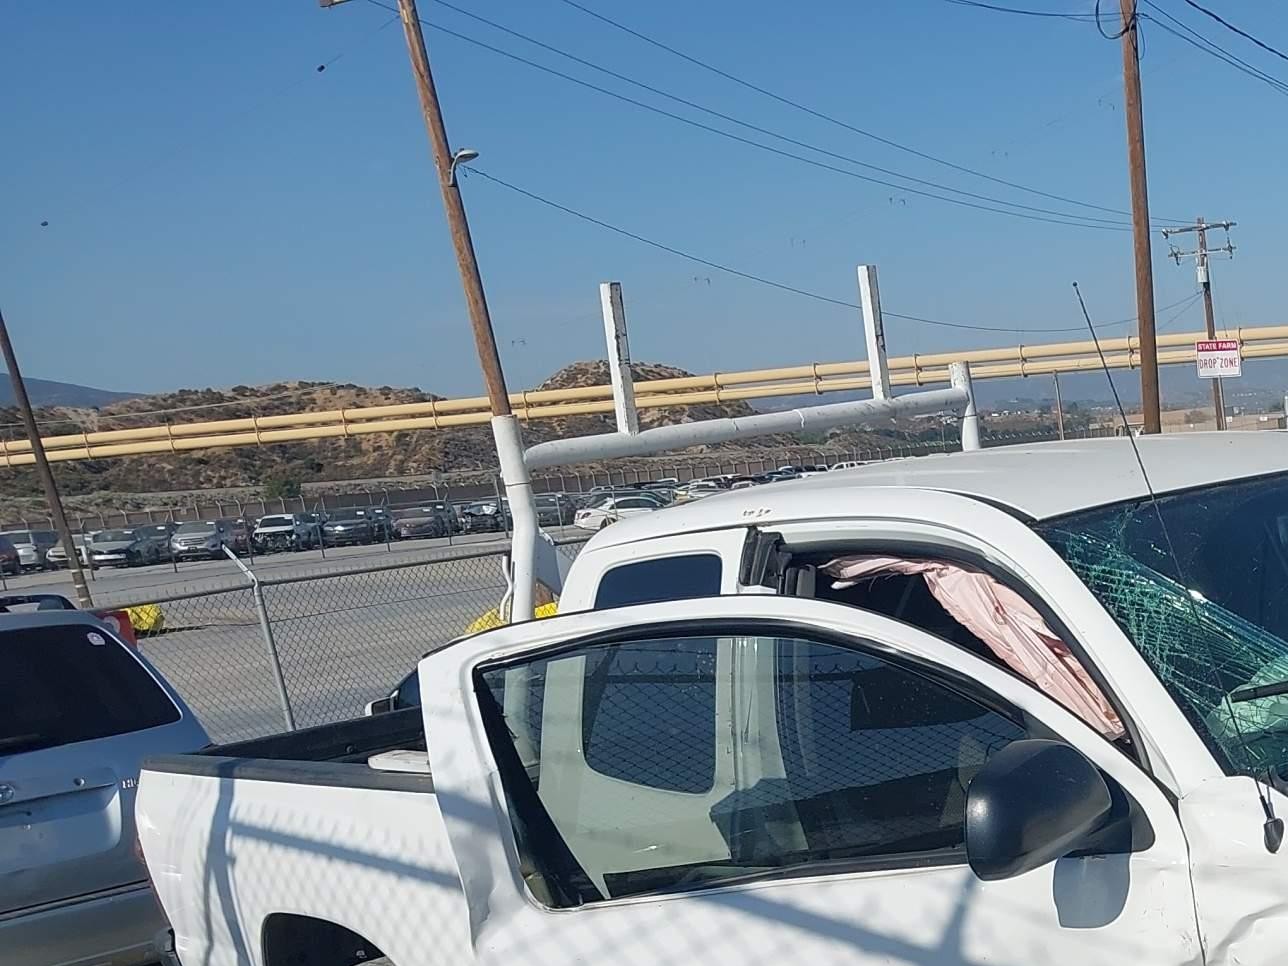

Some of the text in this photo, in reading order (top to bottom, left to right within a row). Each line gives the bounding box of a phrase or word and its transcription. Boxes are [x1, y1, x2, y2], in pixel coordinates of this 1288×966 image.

[1218, 342, 1237, 350] FARM
[1199, 357, 1239, 369] DROP ZONE
